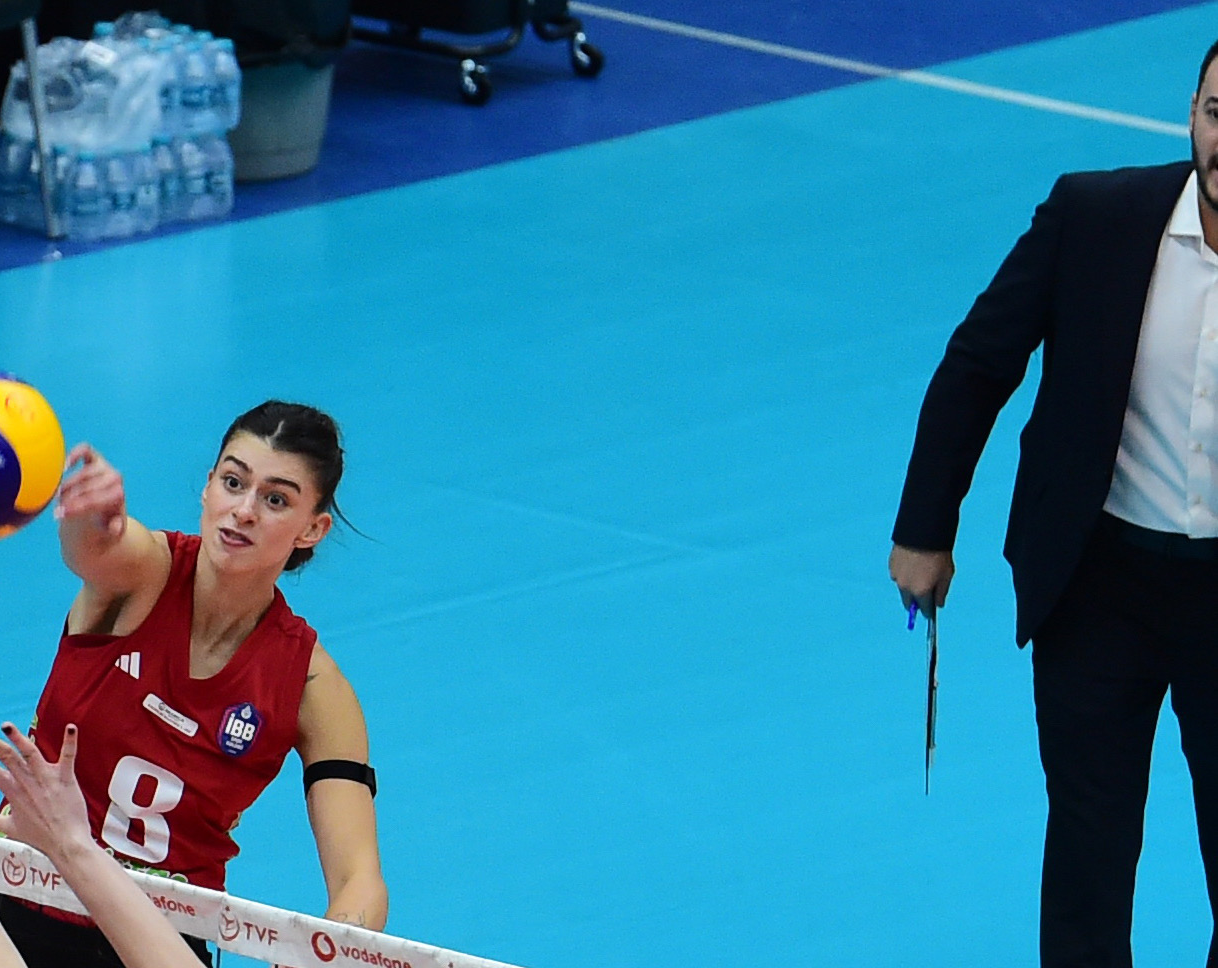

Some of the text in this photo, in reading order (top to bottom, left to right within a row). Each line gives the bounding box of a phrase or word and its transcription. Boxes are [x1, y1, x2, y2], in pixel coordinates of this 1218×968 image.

[101, 755, 184, 864] 8
[29, 867, 62, 891] TVF
[145, 893, 196, 917] afone
[243, 922, 279, 946] TVF
